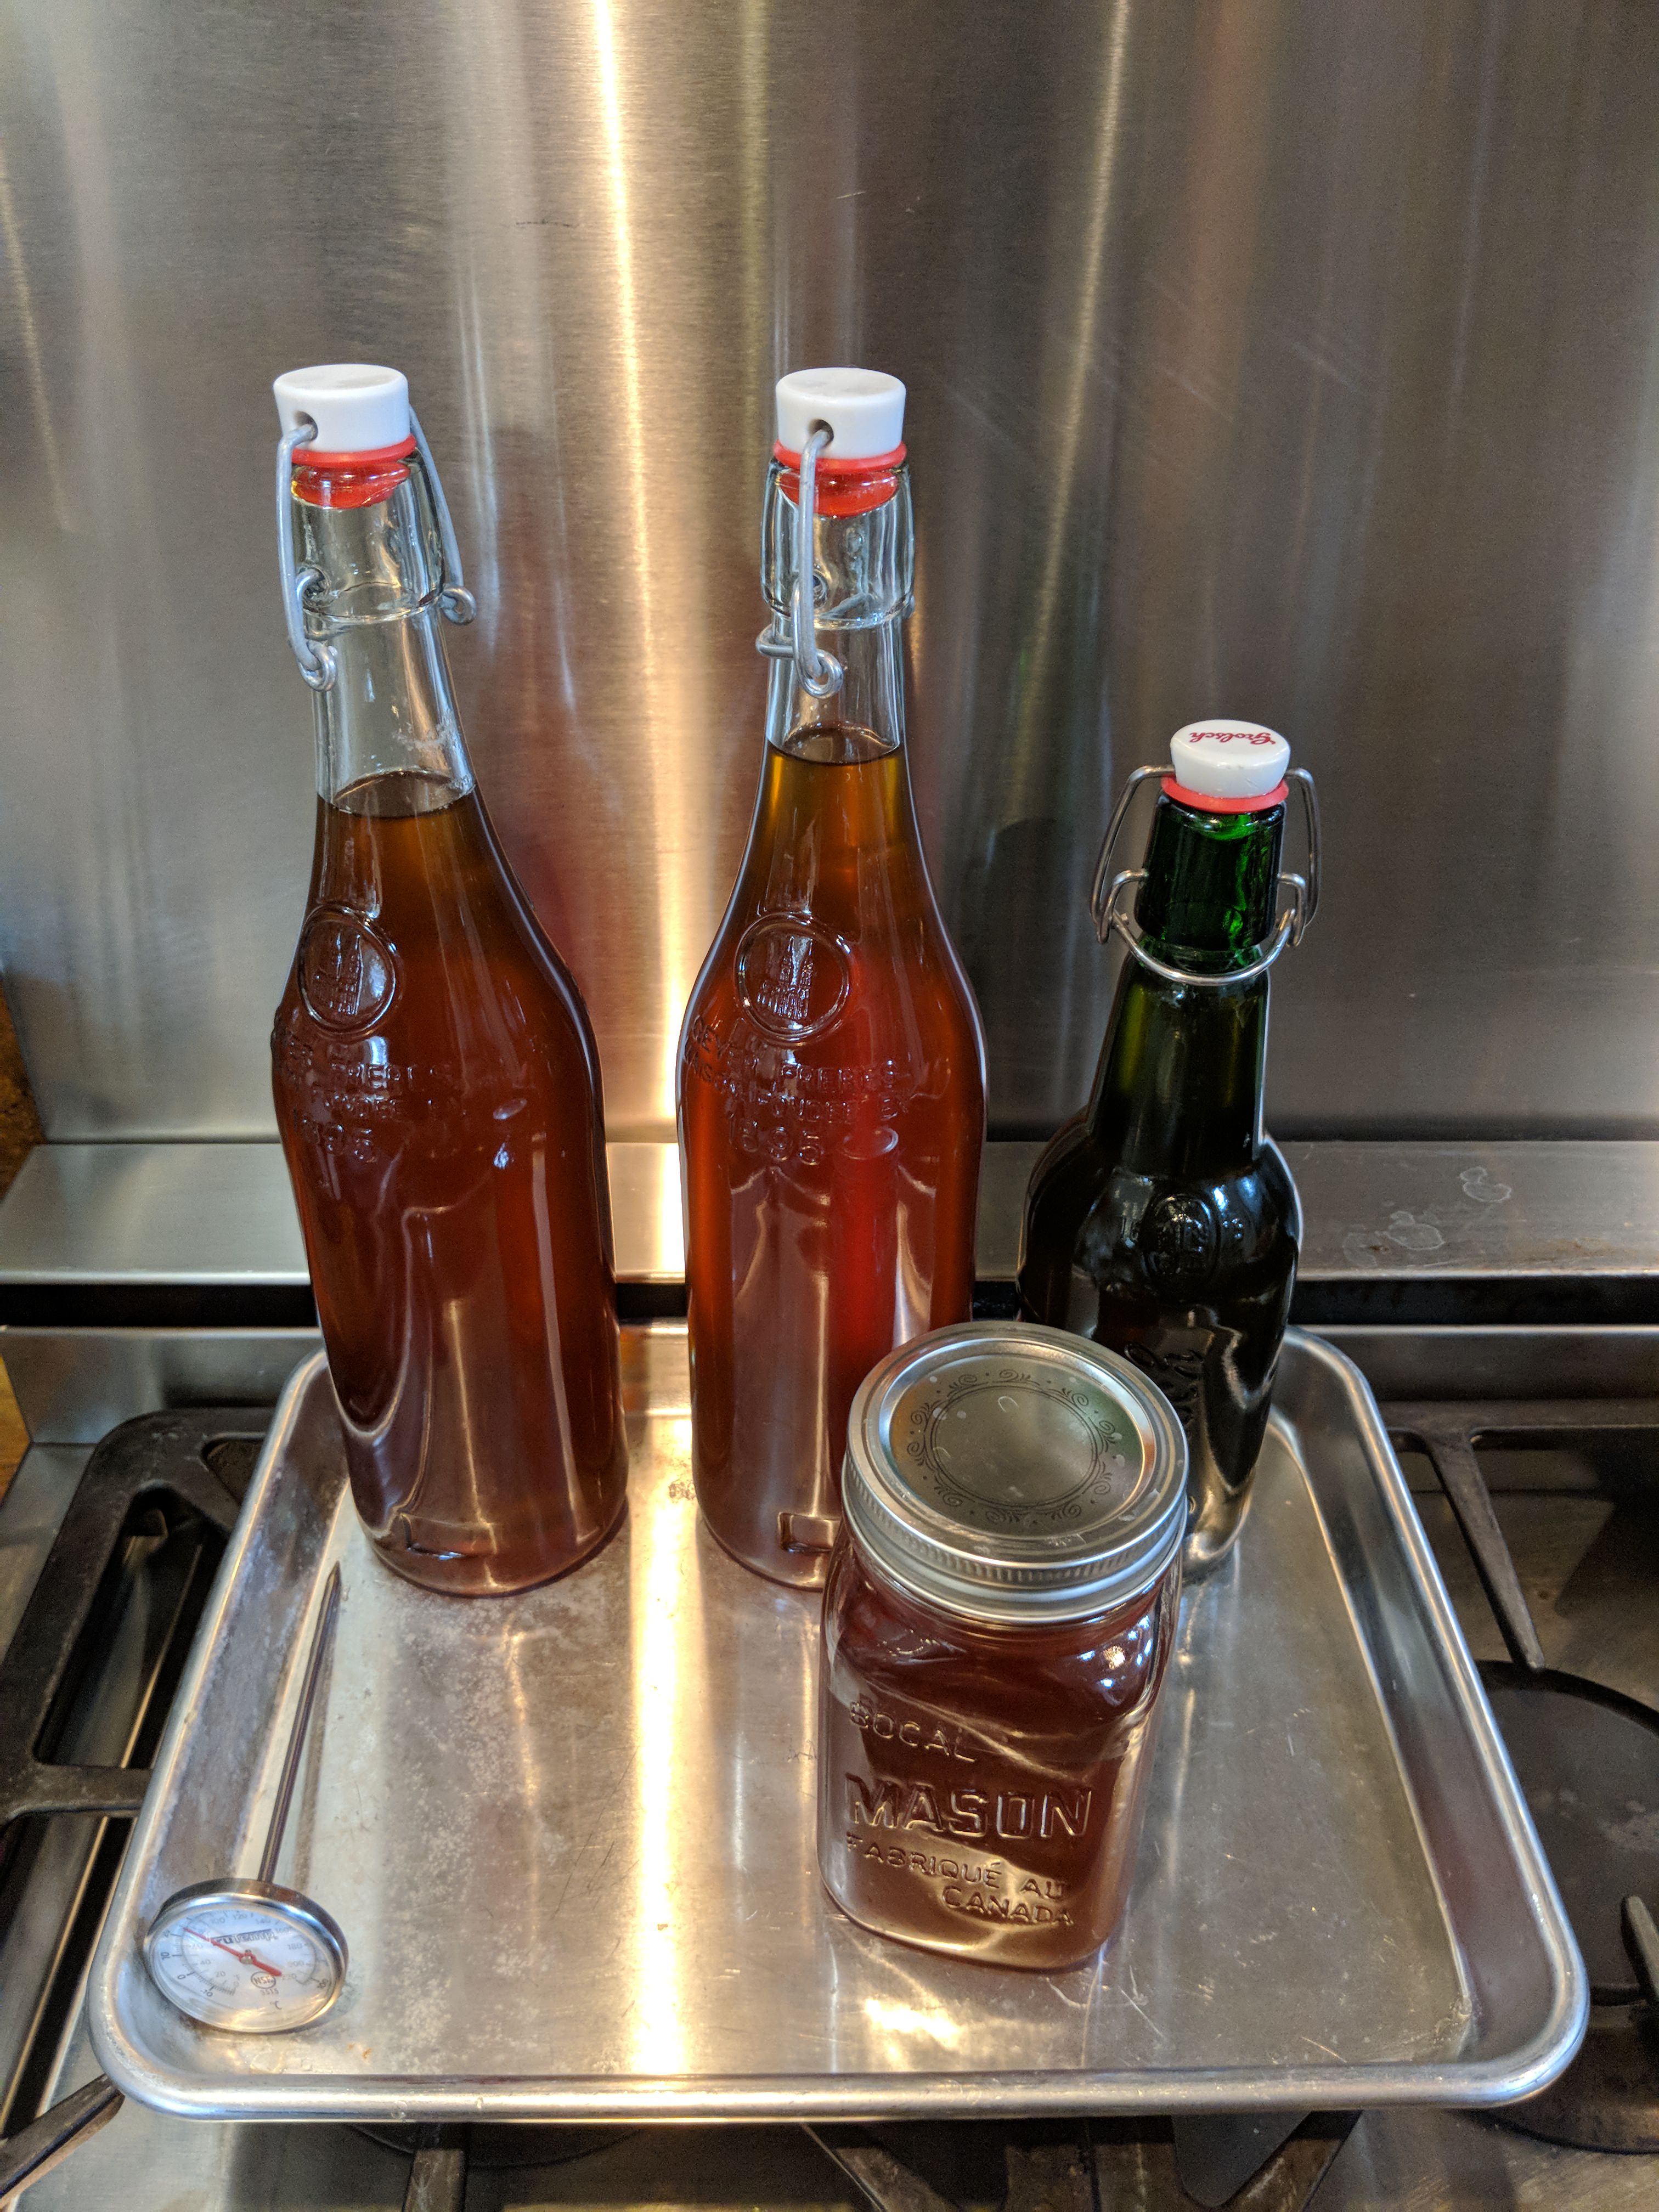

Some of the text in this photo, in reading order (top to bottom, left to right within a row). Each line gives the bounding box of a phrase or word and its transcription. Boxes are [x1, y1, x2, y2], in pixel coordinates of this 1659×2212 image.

[1189, 732, 1277, 745] Grolsch
[850, 1700, 976, 1763] BOCAL
[845, 1771, 1092, 1838] MASON
[846, 1831, 1068, 1900] FABRIQUÉ AU
[942, 1885, 1075, 1926] CANADA
